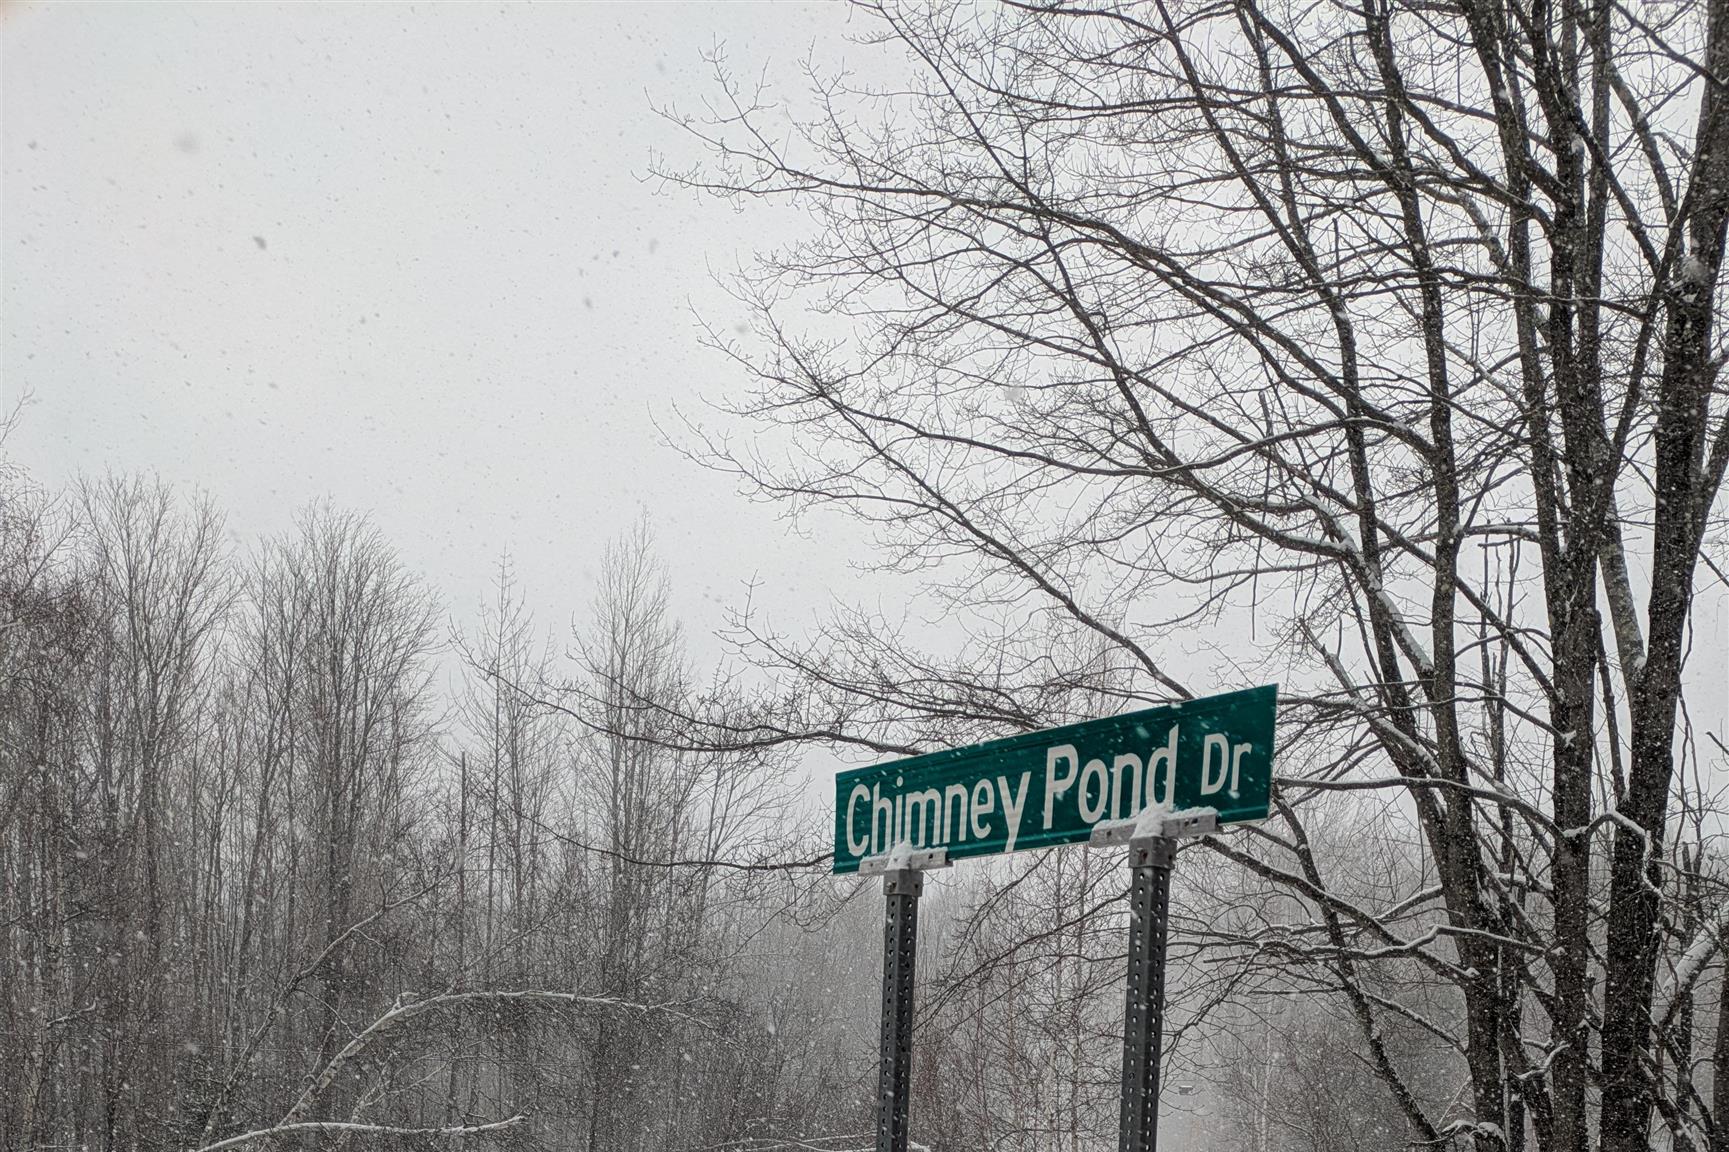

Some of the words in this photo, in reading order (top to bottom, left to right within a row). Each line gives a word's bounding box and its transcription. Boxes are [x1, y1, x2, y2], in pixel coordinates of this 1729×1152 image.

[846, 771, 1031, 857] Chimney
[1043, 723, 1179, 830] Pond
[1200, 733, 1253, 796] Dr
